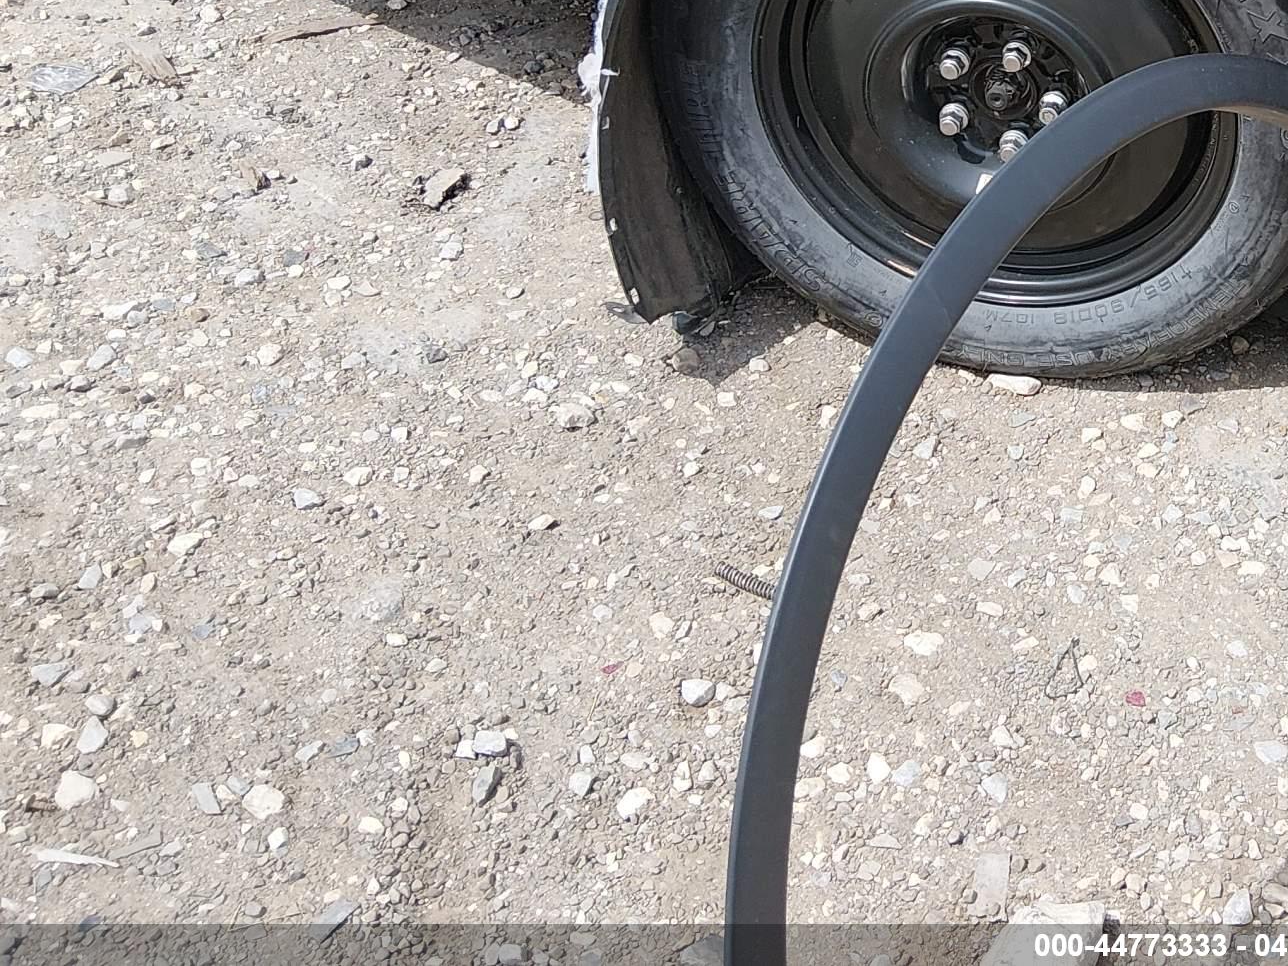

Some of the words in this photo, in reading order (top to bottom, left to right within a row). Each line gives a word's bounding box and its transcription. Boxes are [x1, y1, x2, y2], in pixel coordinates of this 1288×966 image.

[713, 170, 824, 291] SPARE
[984, 309, 1036, 326] 107M
[954, 344, 1026, 367] ONLY
[1035, 350, 1094, 368] USE
